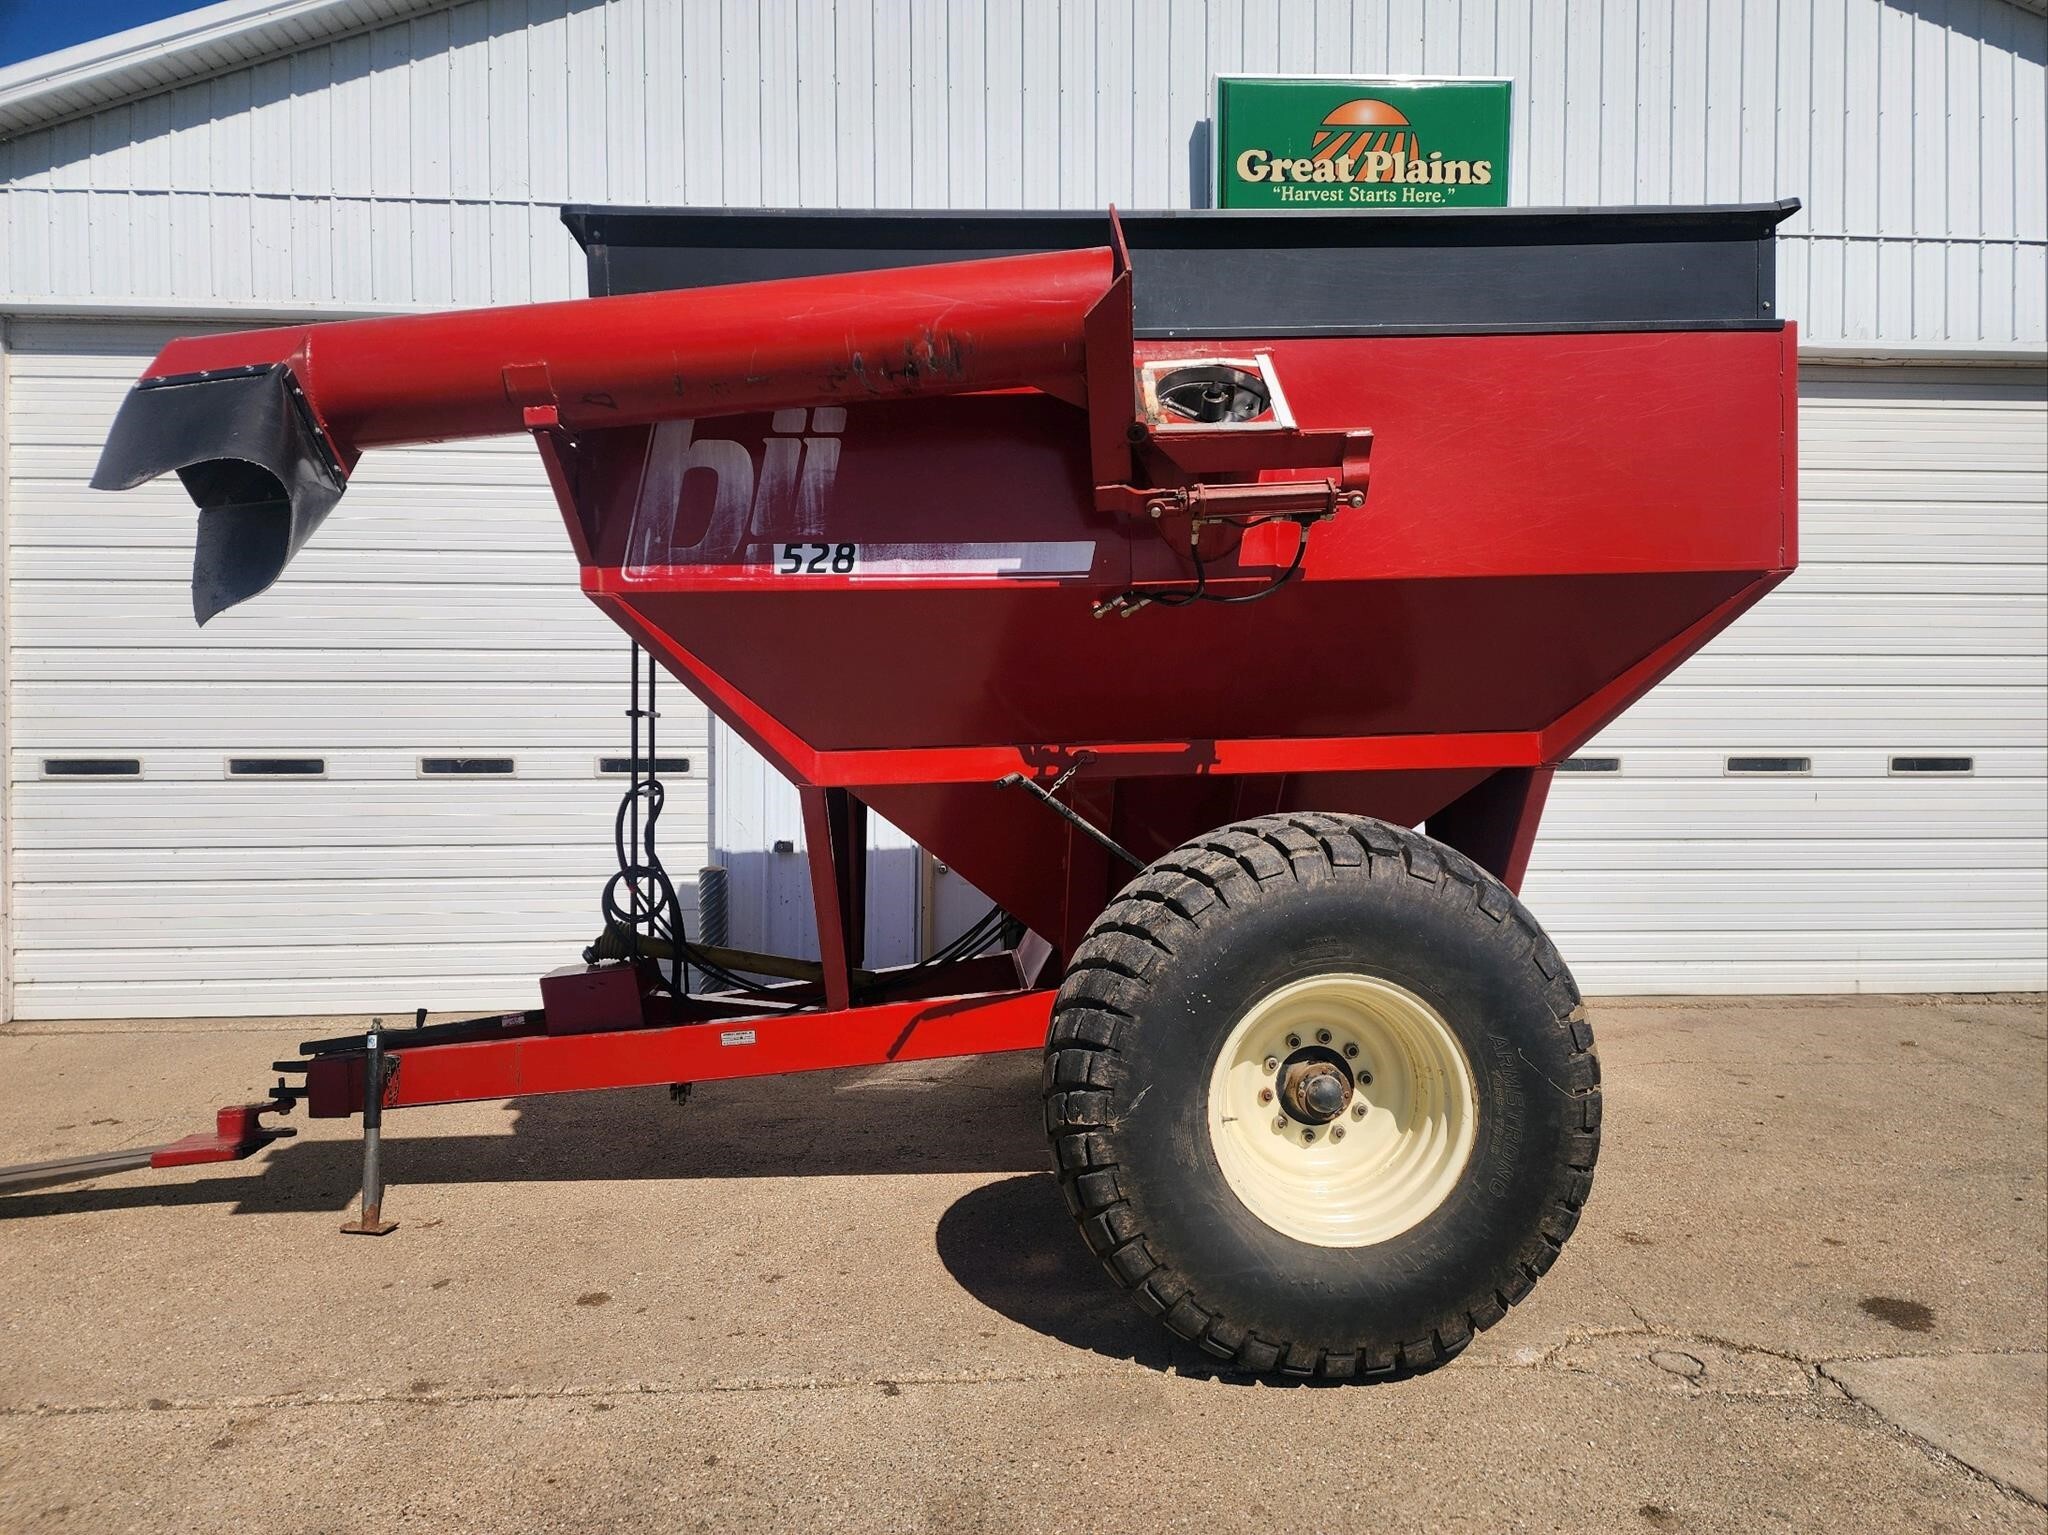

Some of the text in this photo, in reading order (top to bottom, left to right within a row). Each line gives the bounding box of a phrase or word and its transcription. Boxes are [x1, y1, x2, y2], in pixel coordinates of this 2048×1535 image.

[1236, 149, 1492, 184] Great Plains
[1273, 186, 1456, 204] “Harvest Starts Here.”
[780, 543, 856, 575] 528
[1488, 1033, 1526, 1198] ARMSTRONG
